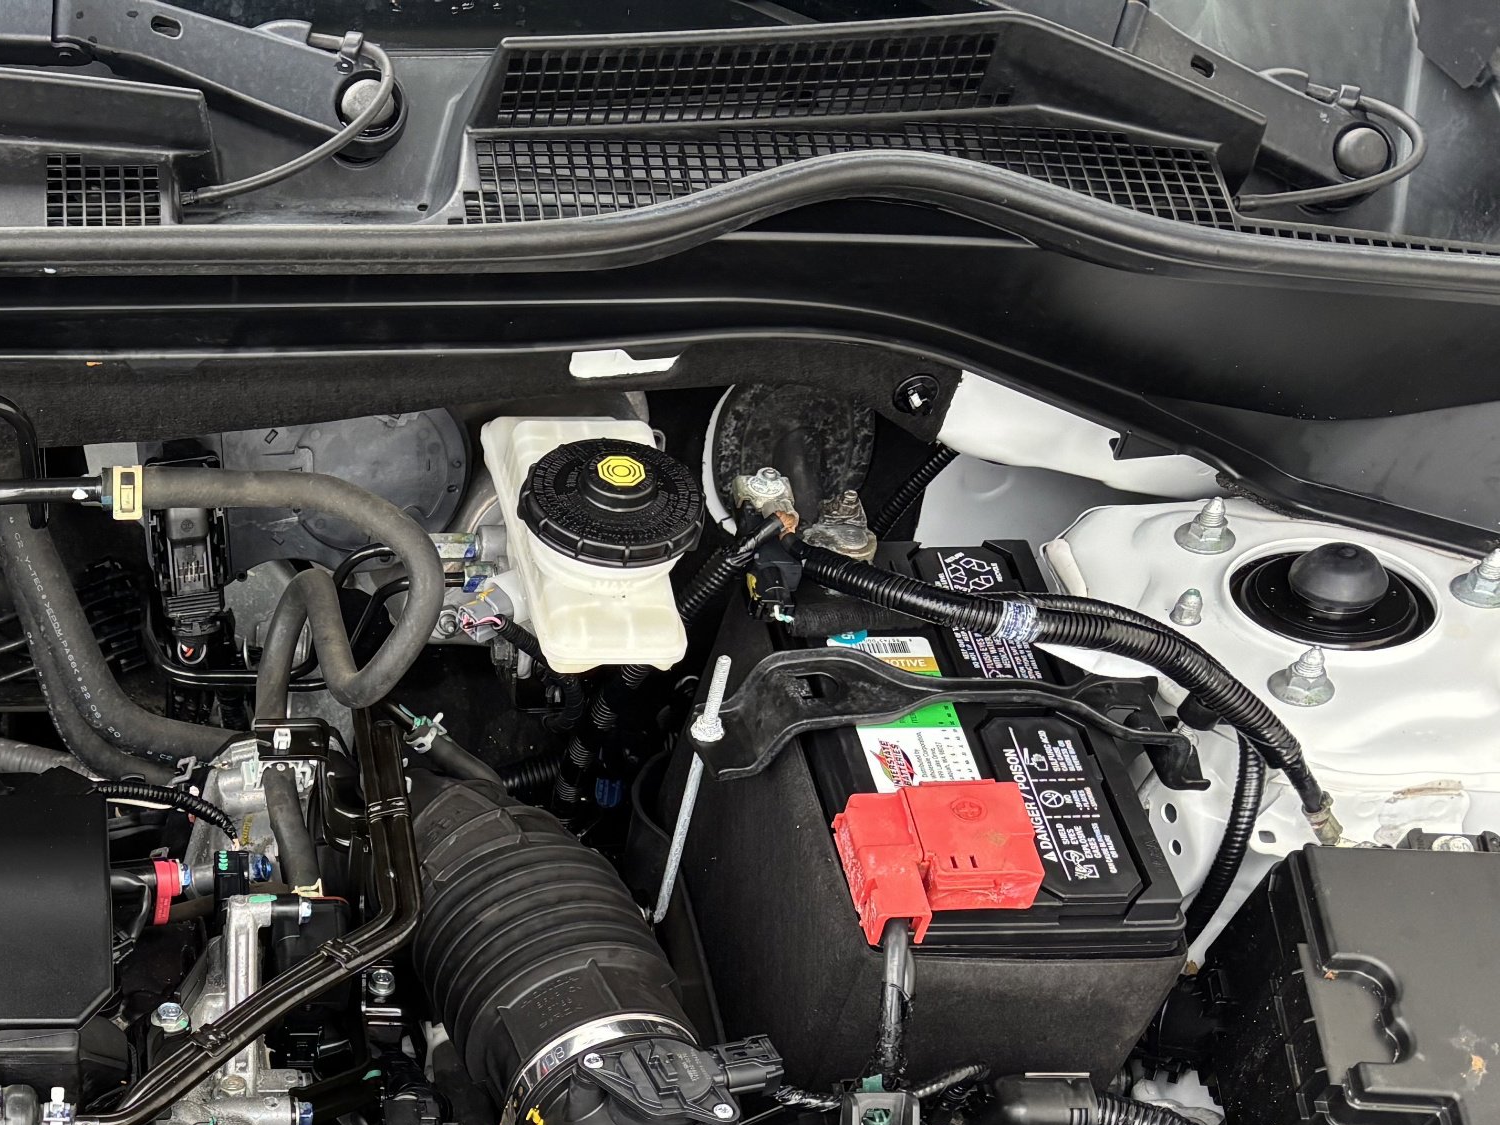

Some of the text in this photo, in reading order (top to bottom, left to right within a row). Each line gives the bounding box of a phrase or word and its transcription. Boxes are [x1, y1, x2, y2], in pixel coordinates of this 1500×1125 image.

[25, 555, 43, 592] Y-TEC
[80, 685, 91, 700] 22
[107, 726, 121, 738] 20
[879, 741, 903, 787] INTERSTATE
[890, 744, 912, 786] BATTERIES
[1003, 749, 1030, 789] POISON
[1038, 731, 1060, 771] SULFURIC ACID
[1064, 795, 1073, 804] NO
[1025, 803, 1053, 849] DANGER
[1056, 824, 1070, 845] SHIELD
[1067, 829, 1078, 844] EYES
[1074, 826, 1093, 858] EXPLOSIVE
[1088, 838, 1102, 858] GASES
